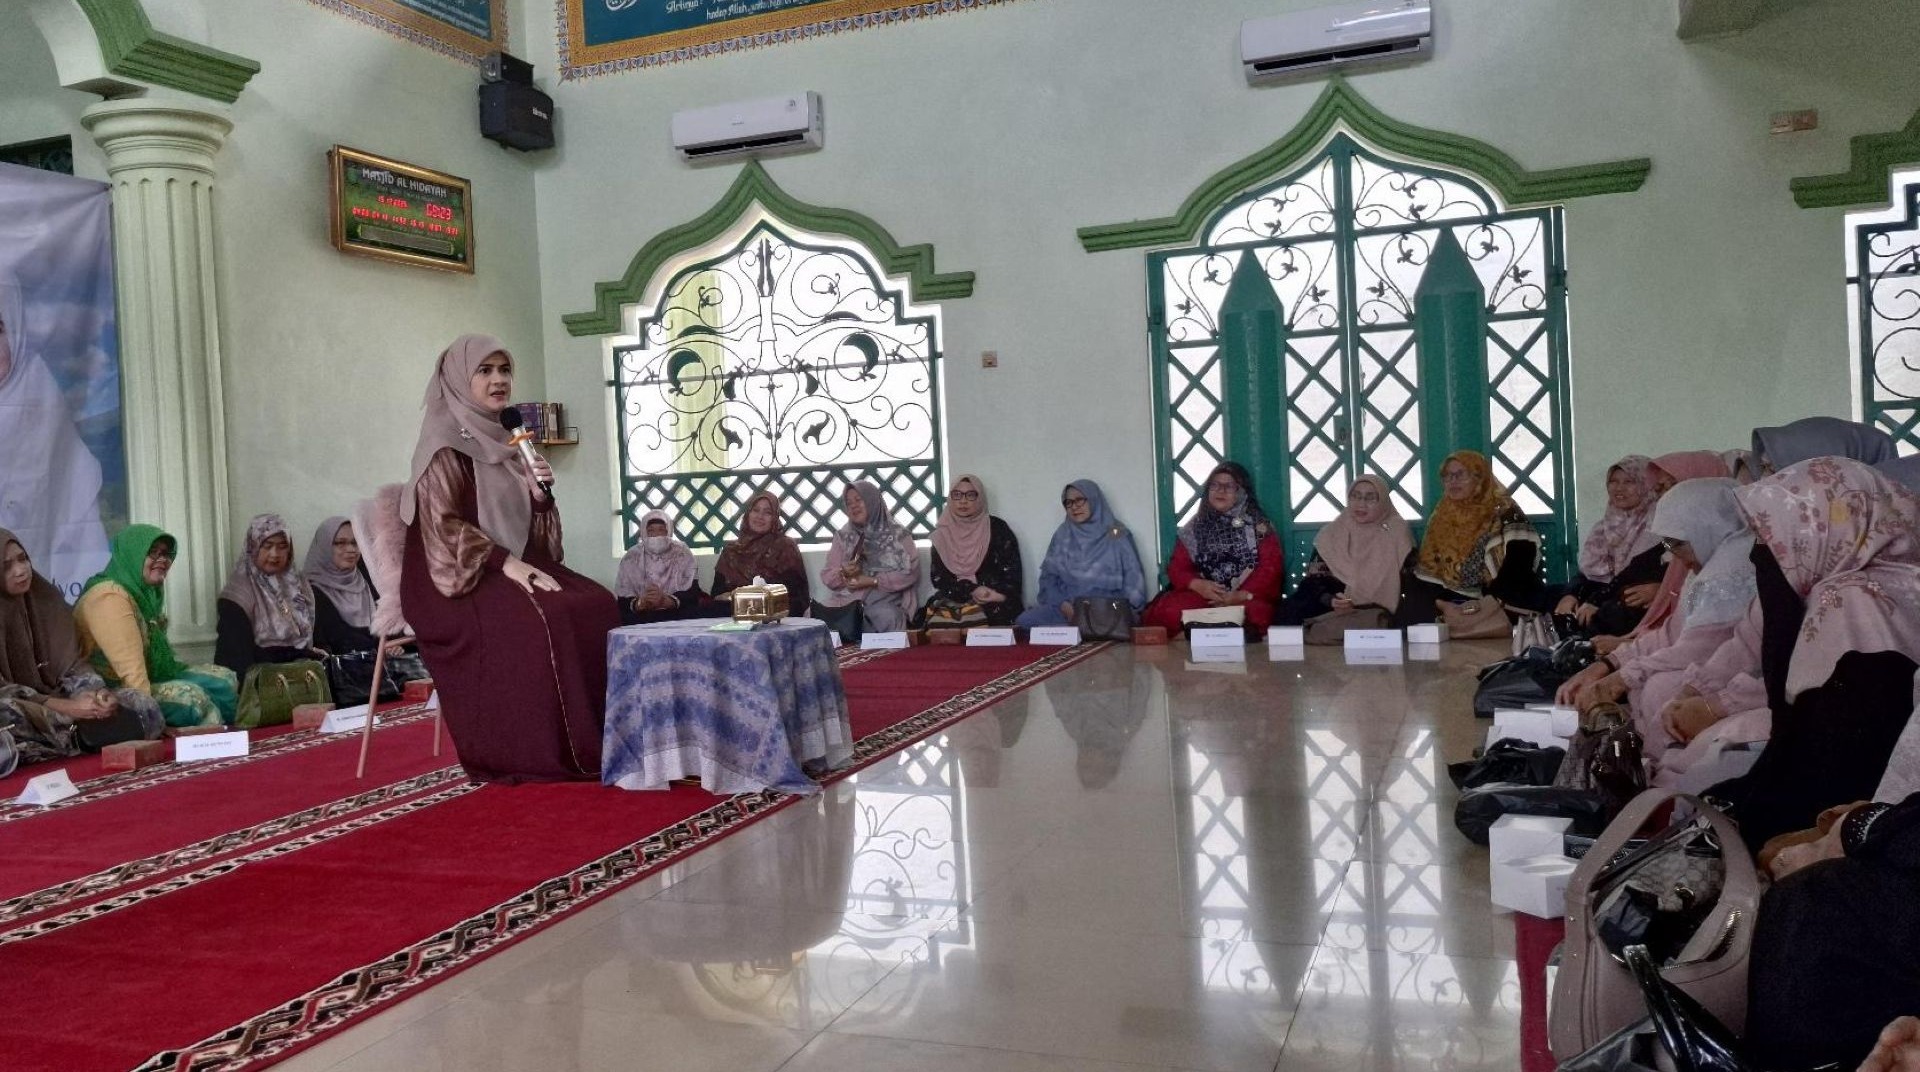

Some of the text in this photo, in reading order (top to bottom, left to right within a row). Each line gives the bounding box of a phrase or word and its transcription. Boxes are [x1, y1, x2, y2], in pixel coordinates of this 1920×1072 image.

[362, 168, 394, 184] MASJID
[397, 177, 408, 188] AL
[409, 179, 447, 197] HIDAYAH
